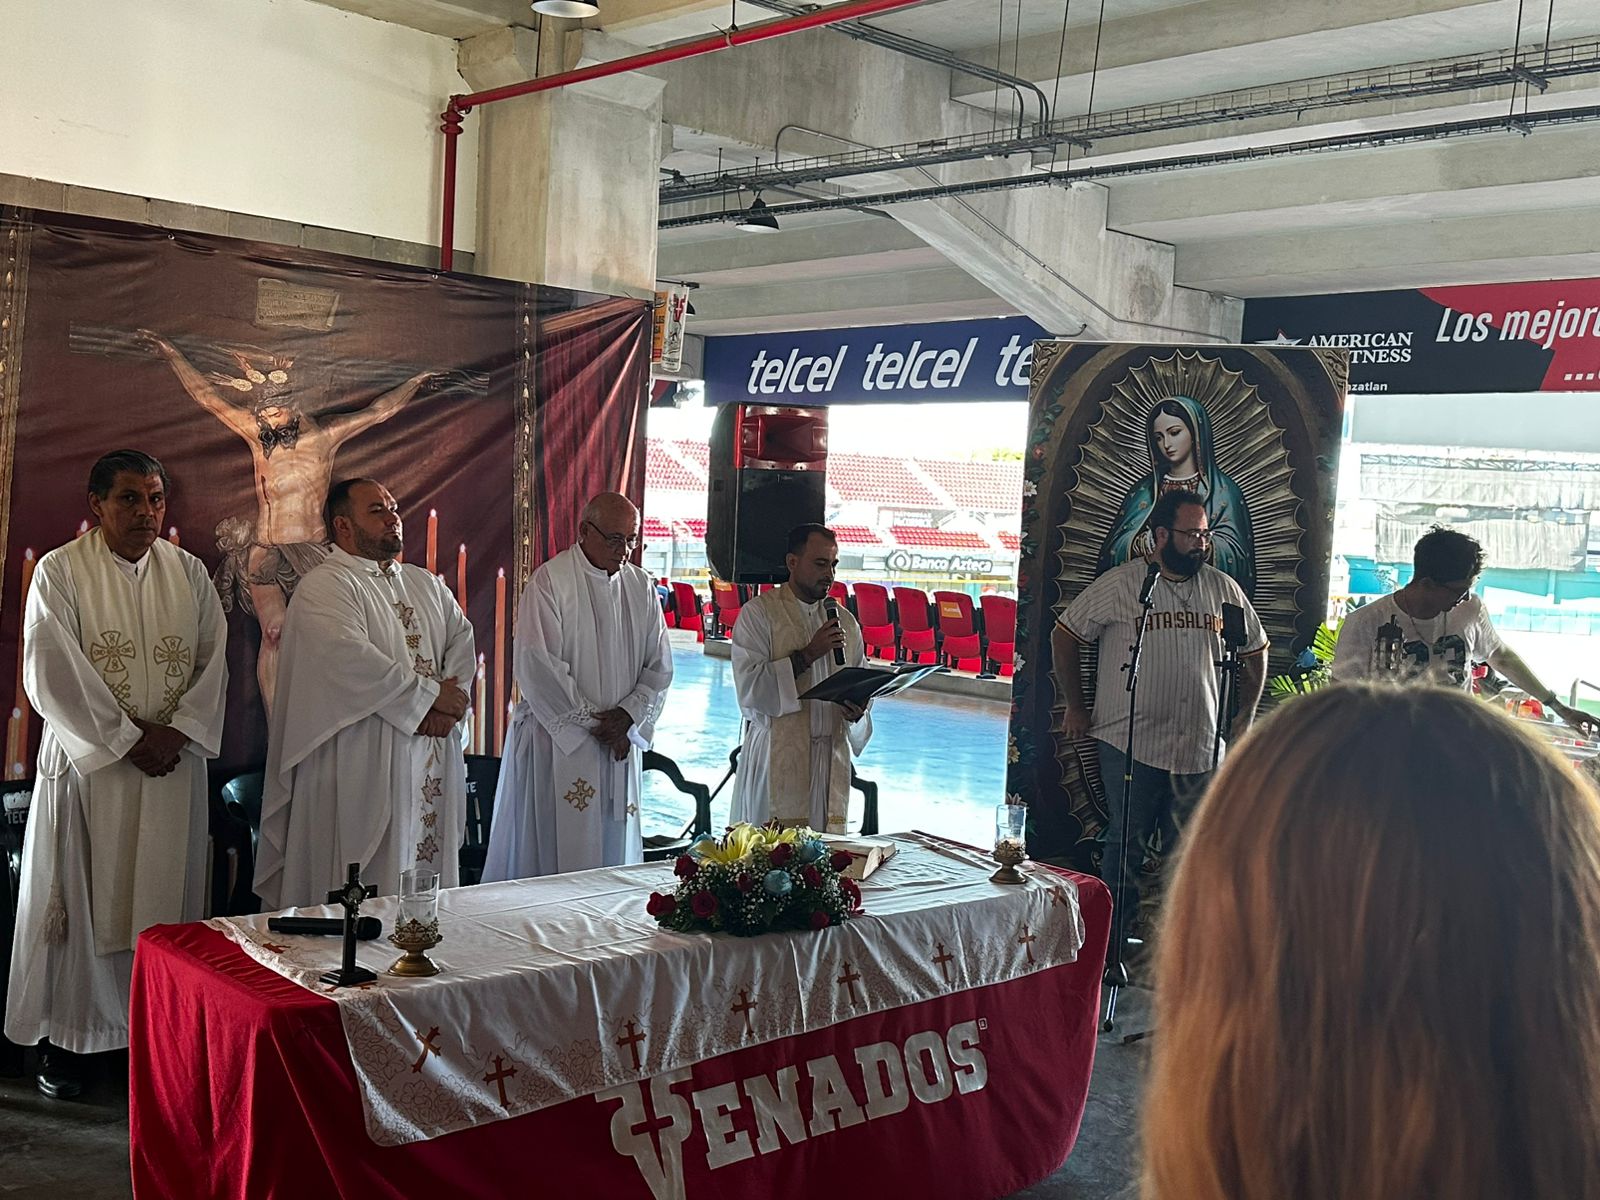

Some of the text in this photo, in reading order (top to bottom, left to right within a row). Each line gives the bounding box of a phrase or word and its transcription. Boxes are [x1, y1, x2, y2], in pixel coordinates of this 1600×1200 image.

[1435, 307, 1494, 343] Los
[1308, 331, 1414, 348] AMERICAN
[1349, 348, 1412, 364] TNESS
[747, 345, 849, 395] telcel
[862, 337, 979, 391] telcel
[911, 554, 992, 572] Banco Azteca
